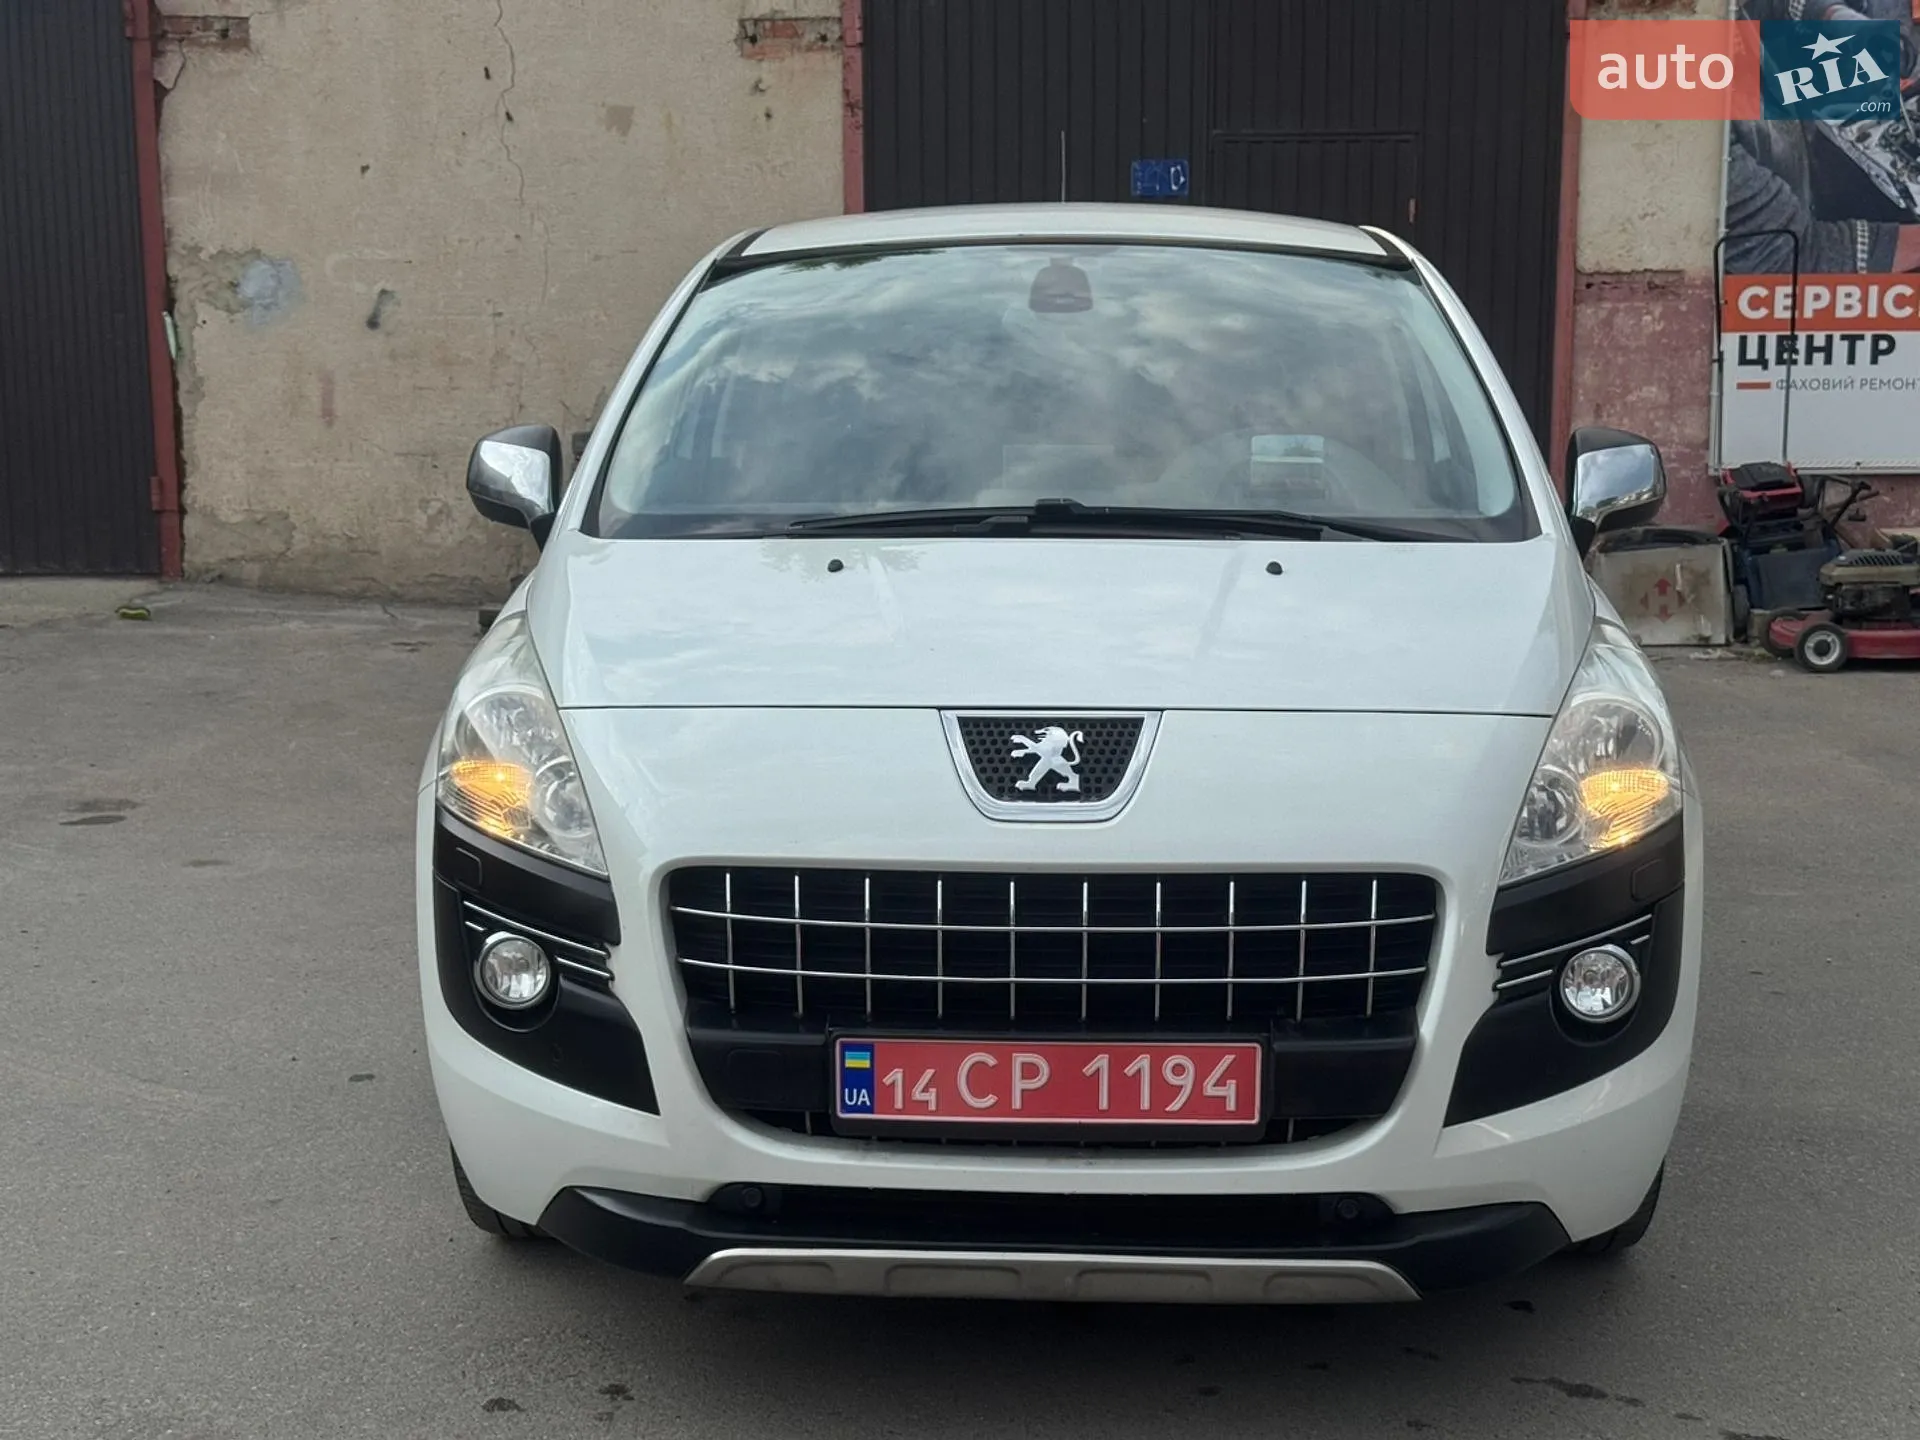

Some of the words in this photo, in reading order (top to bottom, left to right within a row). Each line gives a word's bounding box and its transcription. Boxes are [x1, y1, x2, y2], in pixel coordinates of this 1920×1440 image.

[1737, 284, 1920, 319] СЕРВІС
[1737, 333, 1896, 370] ЦЕНТР
[1775, 376, 1855, 391] ФАХОВИЙ
[1859, 377, 1920, 391] РЕМОН
[844, 1088, 871, 1107] UA
[882, 1068, 937, 1112] 14
[956, 1052, 1050, 1111] CP
[1082, 1053, 1238, 1112] 1194
